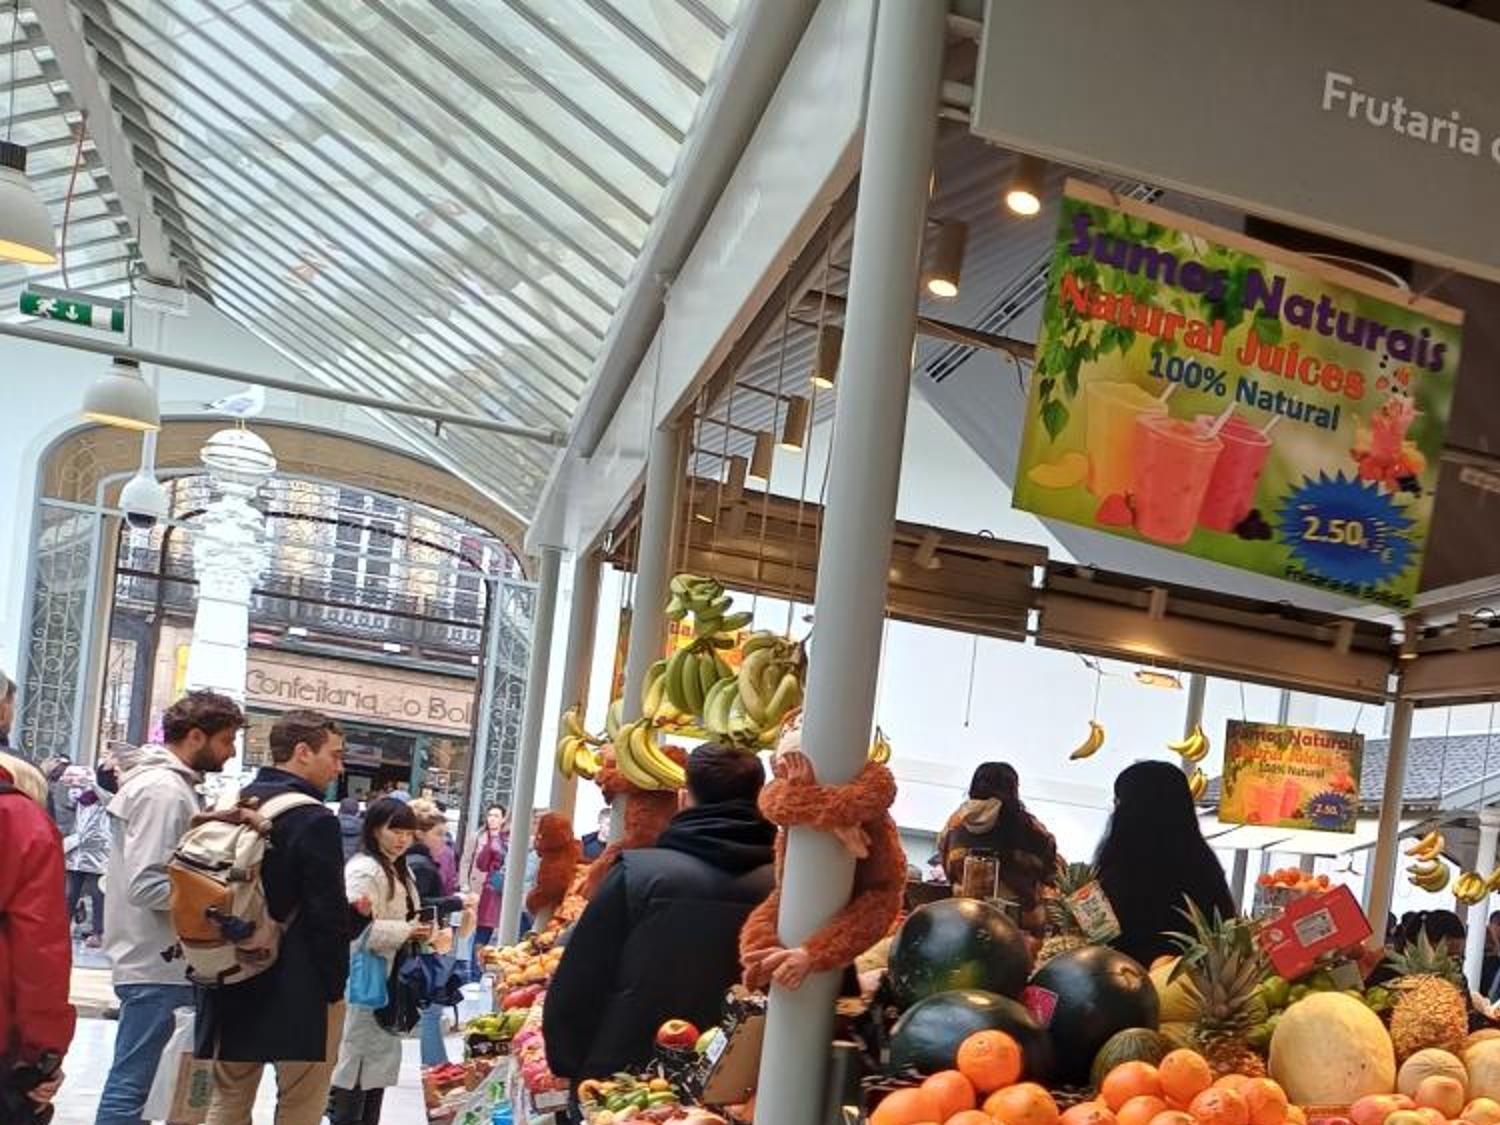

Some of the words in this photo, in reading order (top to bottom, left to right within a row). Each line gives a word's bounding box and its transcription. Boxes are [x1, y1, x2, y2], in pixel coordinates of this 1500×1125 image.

[1321, 71, 1481, 156] Frutaria
[1069, 213, 1231, 305] Sumos
[1241, 267, 1448, 372] Naturais
[1059, 271, 1226, 355] Natural
[1236, 329, 1367, 400] Juices
[1149, 351, 1226, 397] 100%
[1235, 376, 1341, 431] Natural
[245, 669, 377, 711] Confeitaria
